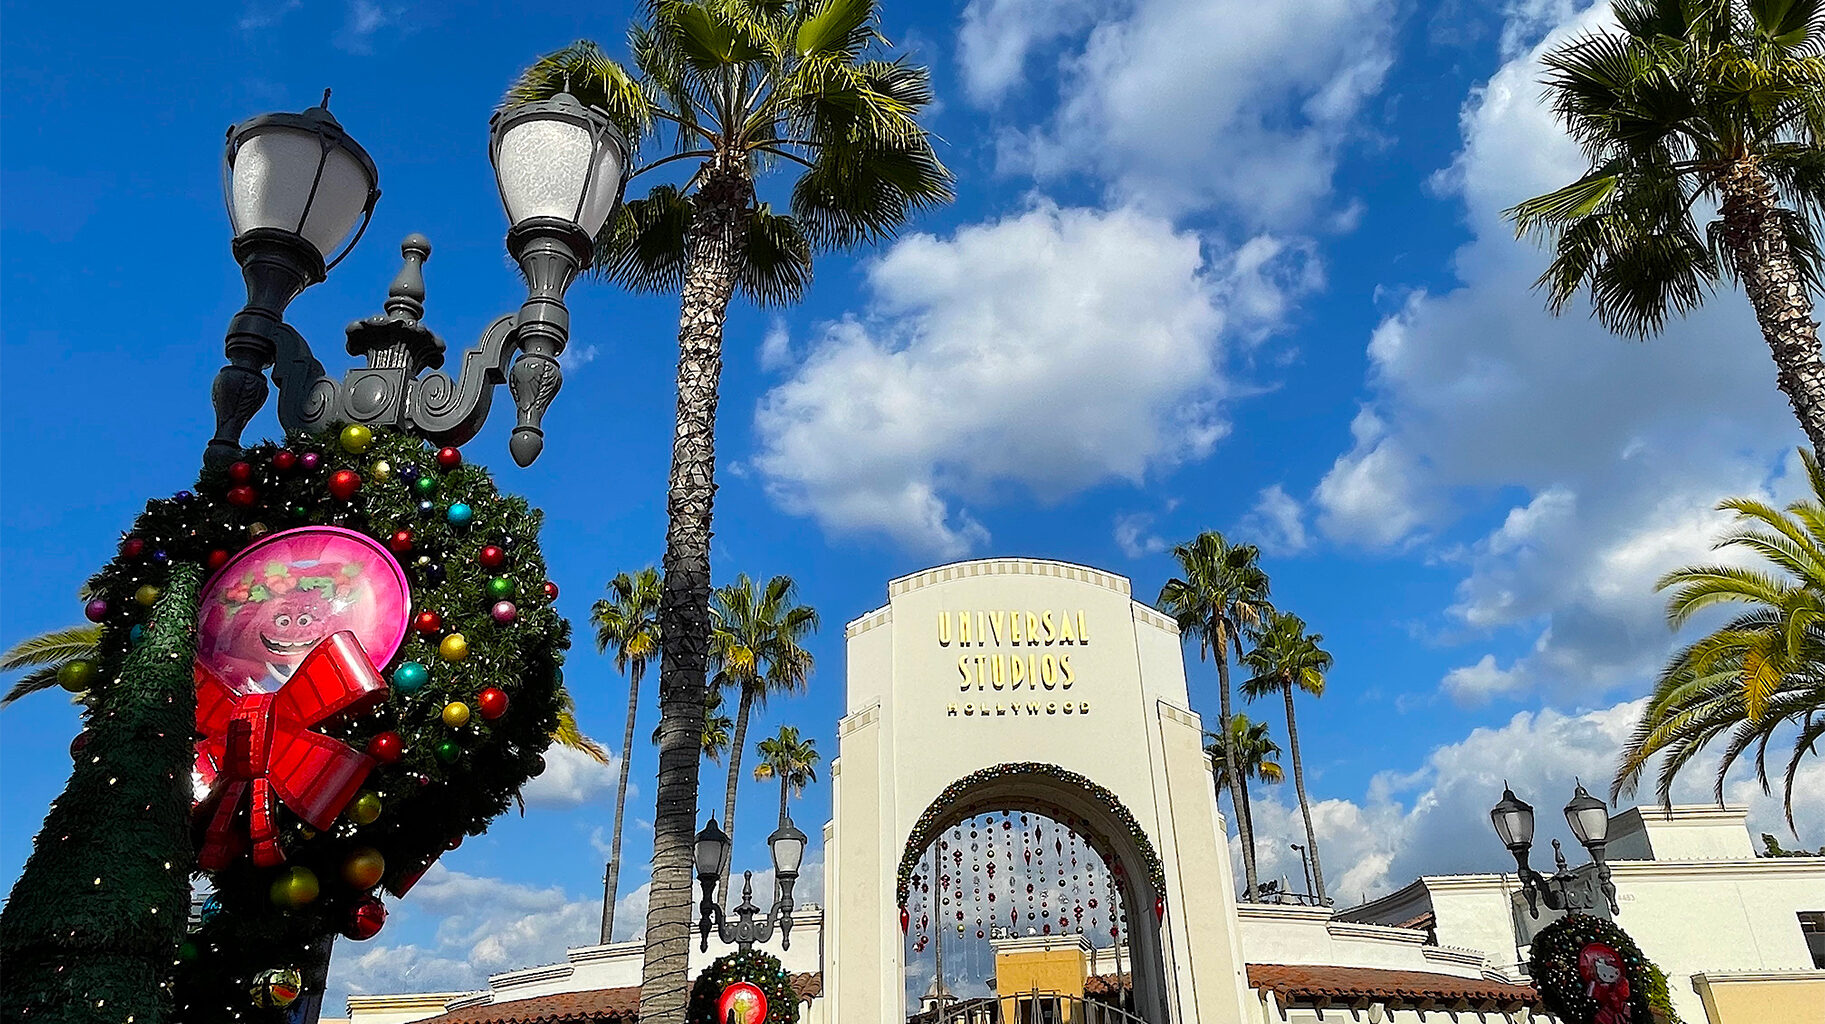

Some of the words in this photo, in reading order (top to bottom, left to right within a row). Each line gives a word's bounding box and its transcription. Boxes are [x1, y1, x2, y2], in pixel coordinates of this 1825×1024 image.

[938, 609, 1089, 647] UNIVERSAL
[958, 653, 1075, 691] STUDIOS
[947, 701, 1090, 716] HOLLYWOOD
